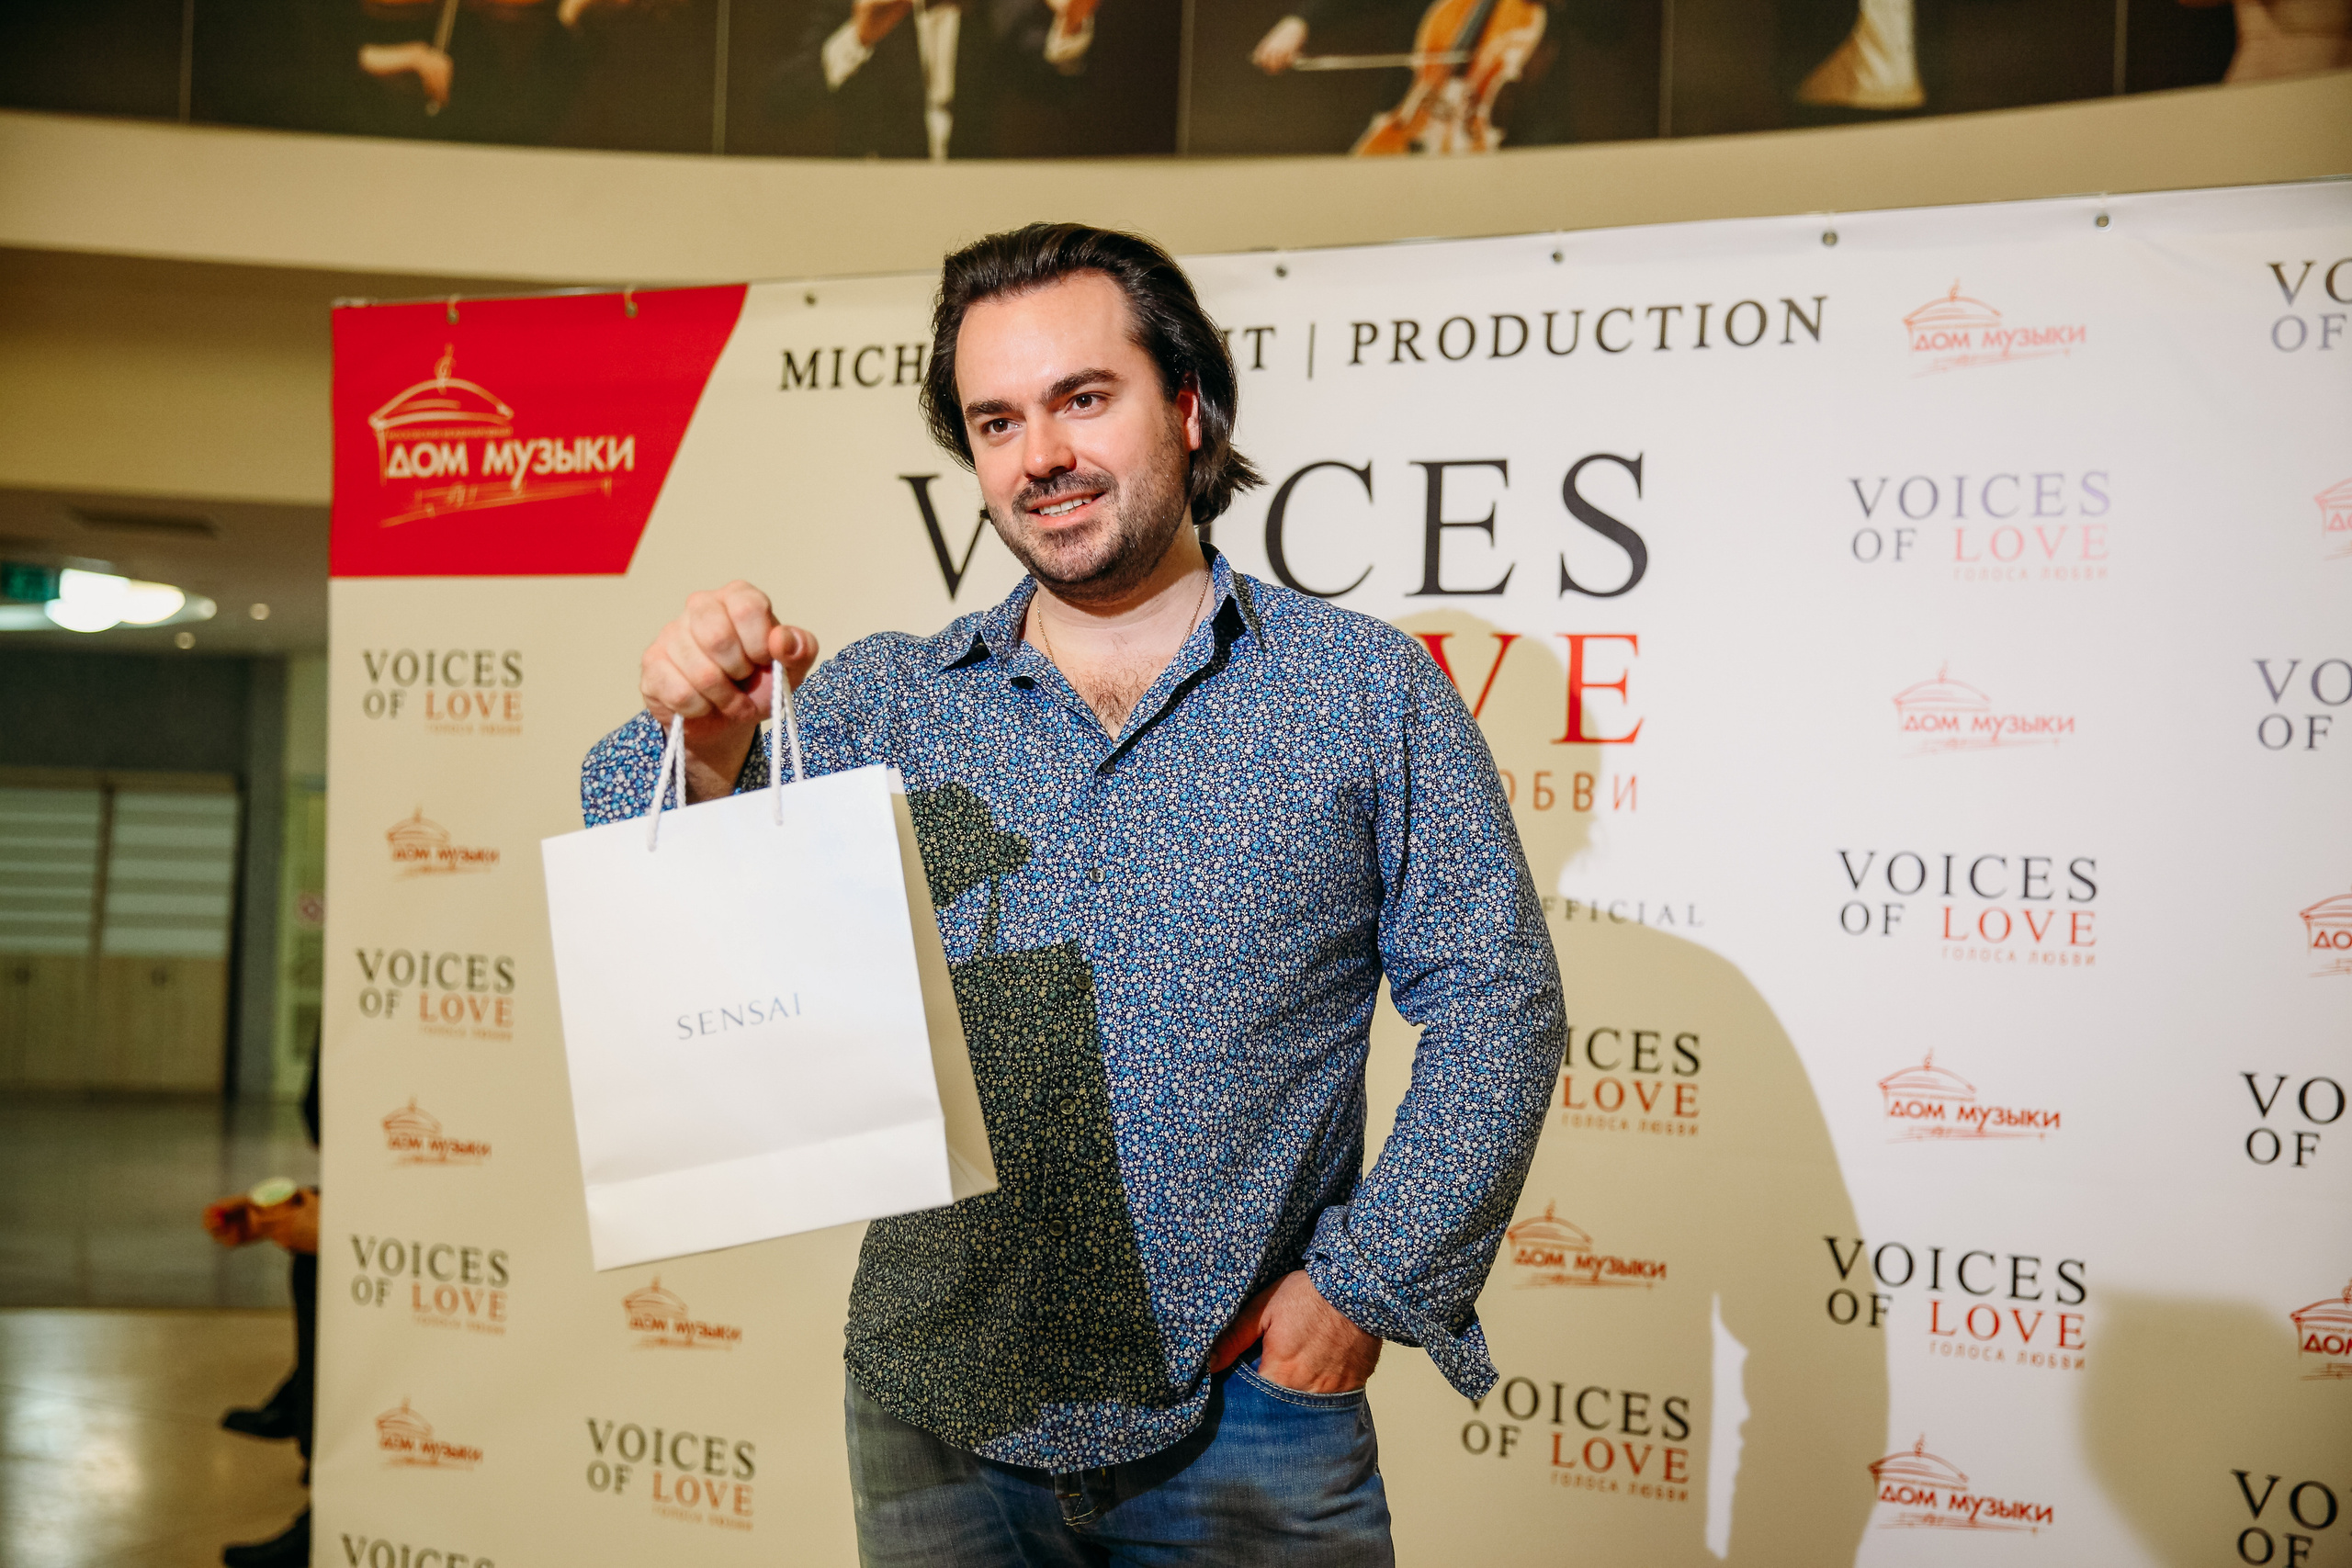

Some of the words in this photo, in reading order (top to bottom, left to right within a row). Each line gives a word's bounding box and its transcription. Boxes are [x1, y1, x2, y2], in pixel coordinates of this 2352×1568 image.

[1348, 295, 1828, 366] PRODUCTION
[1913, 331, 1972, 352] ДОМ
[1982, 324, 2086, 357] МУЗЫКИ
[2271, 312, 2347, 354] OF
[385, 441, 469, 479] ДОМ
[481, 434, 635, 490] МУЗЫКИ
[1848, 469, 2110, 521] VOICES
[1851, 527, 1917, 564] OF
[1953, 523, 2109, 563] LOVE
[362, 648, 524, 689] VOICES
[362, 689, 407, 720] OF
[424, 689, 524, 721] LOVE
[1903, 713, 1960, 732] ДОМ
[1972, 714, 2075, 743] МУЗЫКИ
[2257, 713, 2333, 751] OF
[1837, 849, 2098, 904] VOICES
[1839, 899, 1905, 938] OF
[1942, 905, 2098, 947] LOVE
[355, 947, 514, 995] VOICES
[1942, 946, 2017, 963] ГОЛОСА
[358, 987, 401, 1020] OF
[419, 991, 514, 1028] LOVE
[677, 992, 800, 1040] SENSAI
[1562, 1074, 1700, 1119] LOVE
[1889, 1100, 1946, 1121] ДОМ
[1957, 1104, 2061, 1133] МУЗЫКИ
[2245, 1127, 2321, 1168] OF
[350, 1234, 509, 1289] VOICES
[1824, 1235, 2087, 1306] VOICES
[351, 1274, 393, 1308] OF
[412, 1282, 507, 1323] LOVE
[1827, 1288, 1893, 1328] OF
[1928, 1299, 2086, 1351] LOVE
[1929, 1340, 2006, 1362] ГОЛОСА
[585, 1417, 756, 1482] VOICES
[1461, 1419, 1521, 1459] OF
[1550, 1431, 1690, 1484] LOVE
[586, 1460, 634, 1495] OF
[652, 1471, 753, 1517] LOVE
[1880, 1484, 1937, 1509] ДОМ
[1948, 1494, 2053, 1525] МУЗЫКИ
[2237, 1527, 2313, 1568] OF
